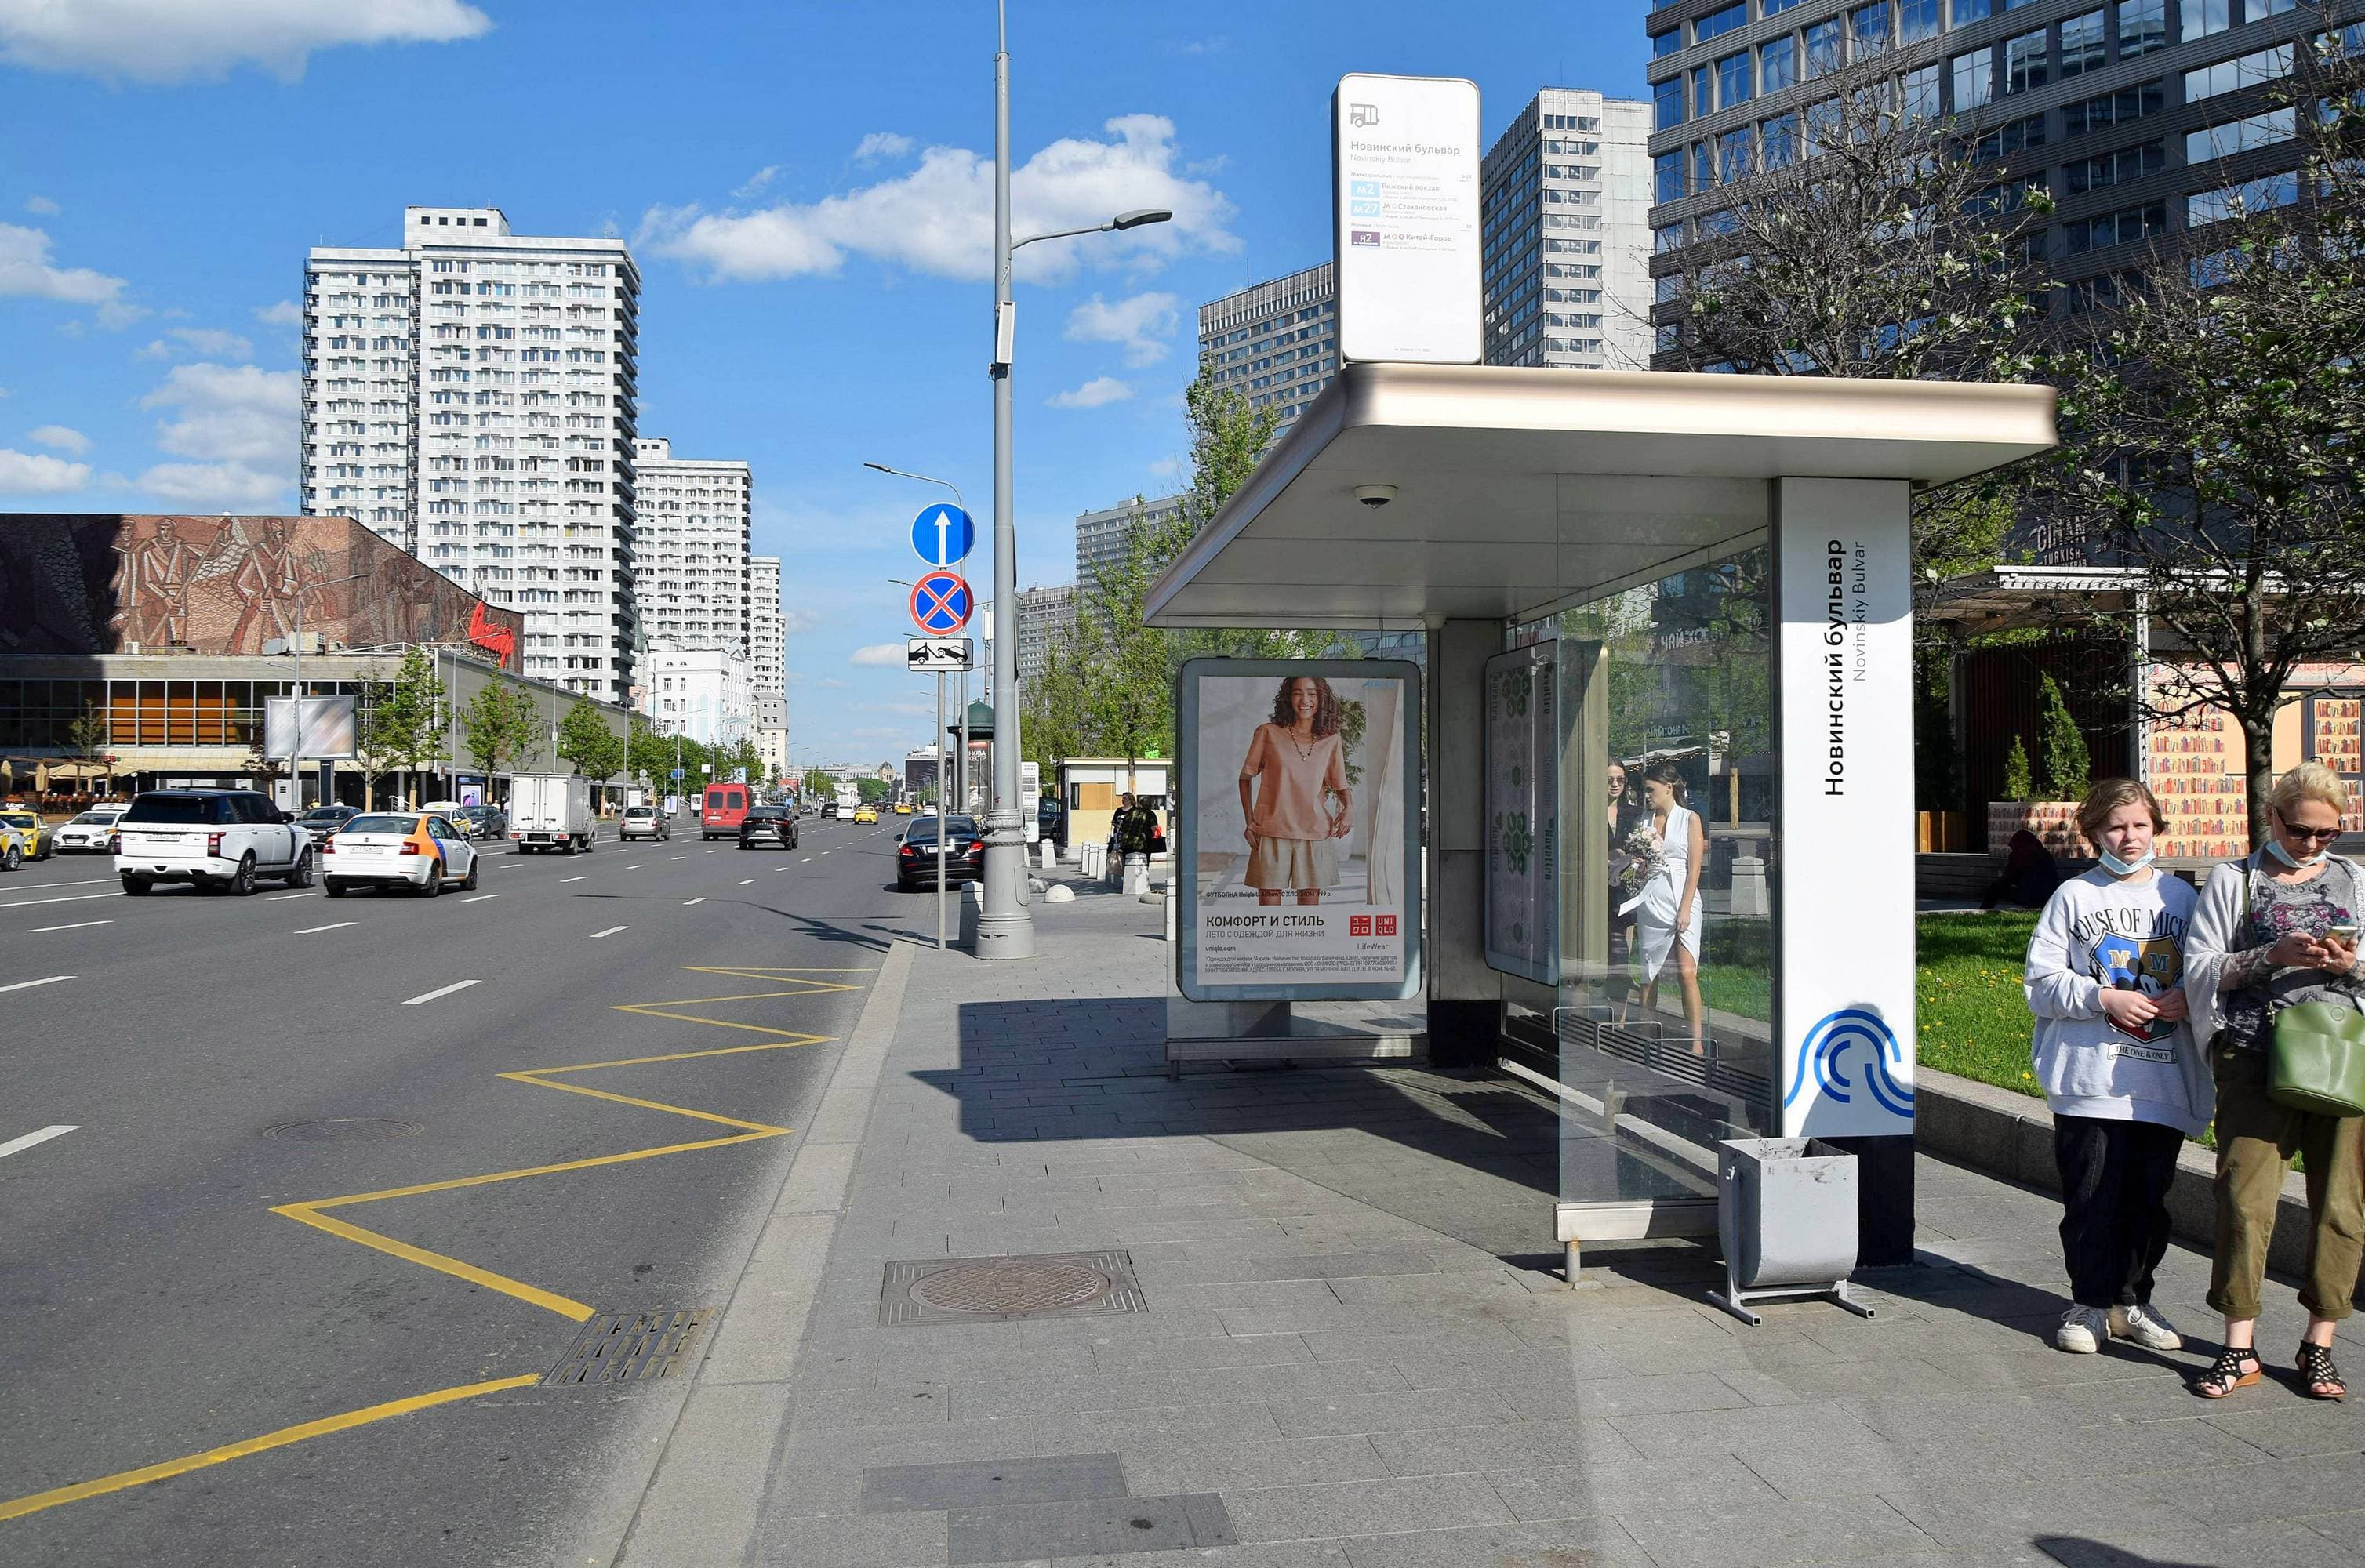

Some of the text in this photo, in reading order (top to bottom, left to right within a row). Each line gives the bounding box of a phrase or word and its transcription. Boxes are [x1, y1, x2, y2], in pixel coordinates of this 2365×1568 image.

[1350, 140, 1460, 156] Новинский бульвар
[1350, 154, 1411, 165] Novinskiy Bulvar
[1406, 234, 1453, 242] Китай-Город
[2043, 547, 2080, 565] TURKISH
[1851, 541, 1869, 681] Novinskiy Bulvar
[1824, 539, 1847, 796] Новинский бульвар
[1206, 916, 1324, 927] КОМФОРТ И СТИЛЬ
[2069, 907, 2189, 948] HOUSE OF MICK
[1233, 929, 1274, 939] ОДЕЖДОЙ
[1276, 930, 1293, 938] ДЛЯ
[1378, 926, 1394, 935] QLO
[2108, 949, 2131, 969] M
[2148, 953, 2170, 973] M
[2115, 1045, 2129, 1054] THE
[2130, 1048, 2145, 1058] ONE
[2152, 1052, 2170, 1061] ONLY
